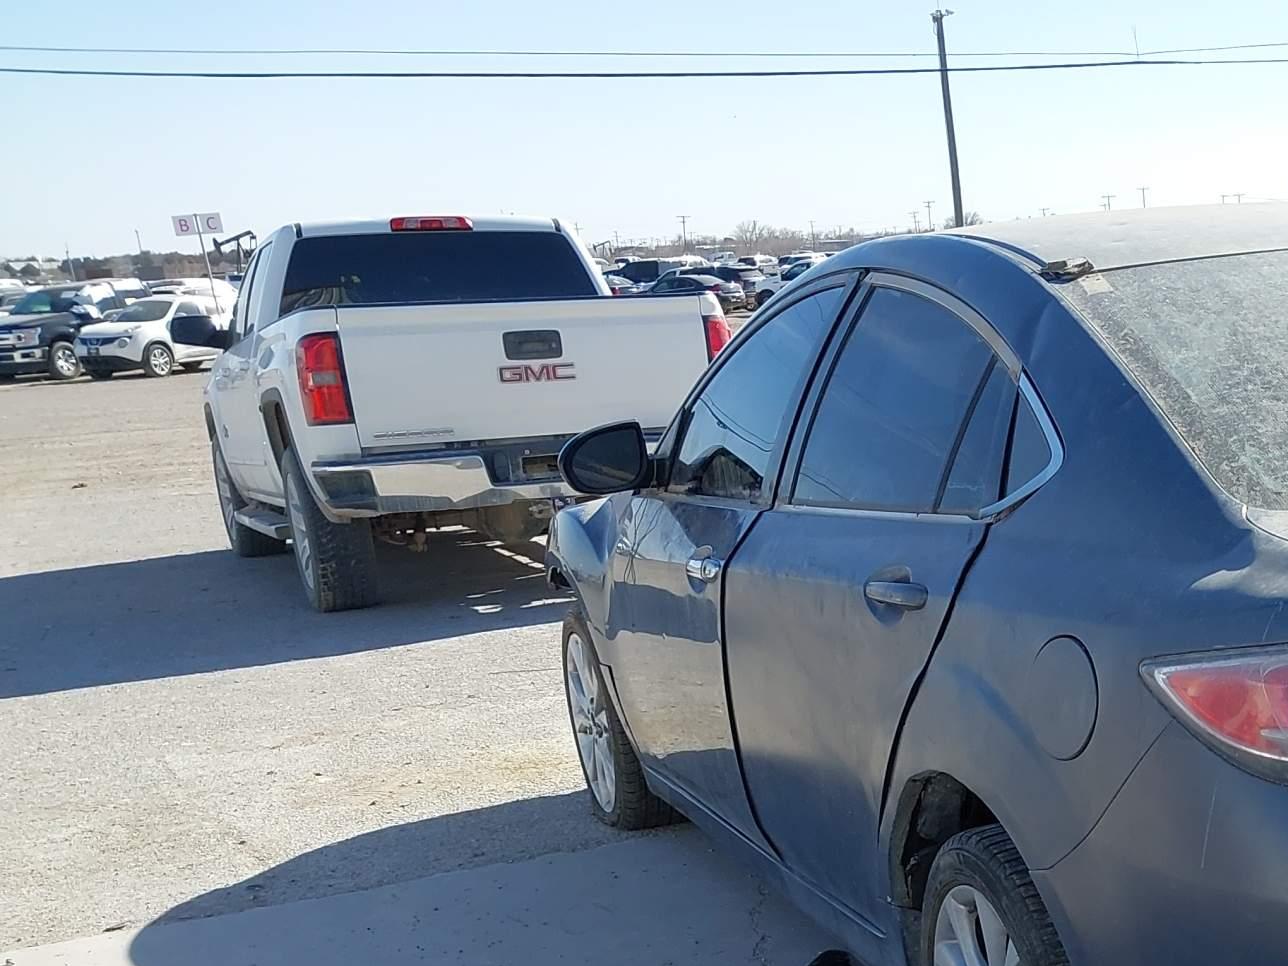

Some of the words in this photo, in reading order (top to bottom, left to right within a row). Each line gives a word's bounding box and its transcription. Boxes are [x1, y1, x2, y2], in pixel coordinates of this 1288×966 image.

[178, 218, 190, 233] B
[206, 216, 217, 230] C
[498, 362, 577, 384] GMC
